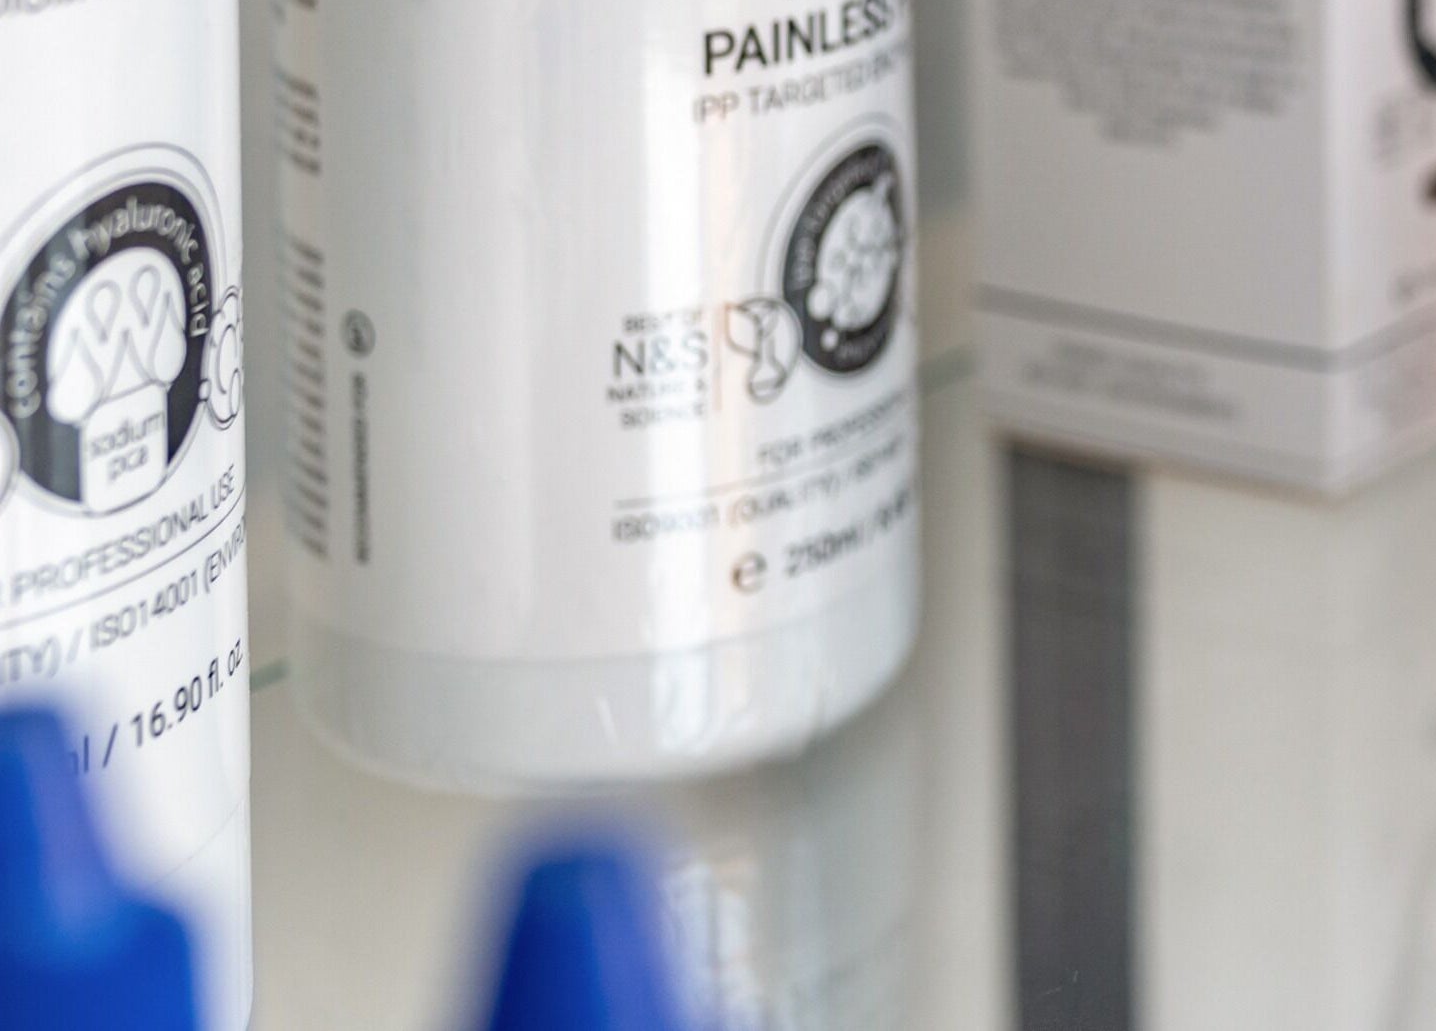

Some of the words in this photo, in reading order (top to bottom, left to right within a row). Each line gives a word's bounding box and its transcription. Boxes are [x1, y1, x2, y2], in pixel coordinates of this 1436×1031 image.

[186, 263, 210, 338] acid
[612, 330, 708, 380] N&S
[10, 499, 208, 604] PROFESSIONAL
[209, 464, 236, 509] USE
[131, 674, 202, 748] 16.90
